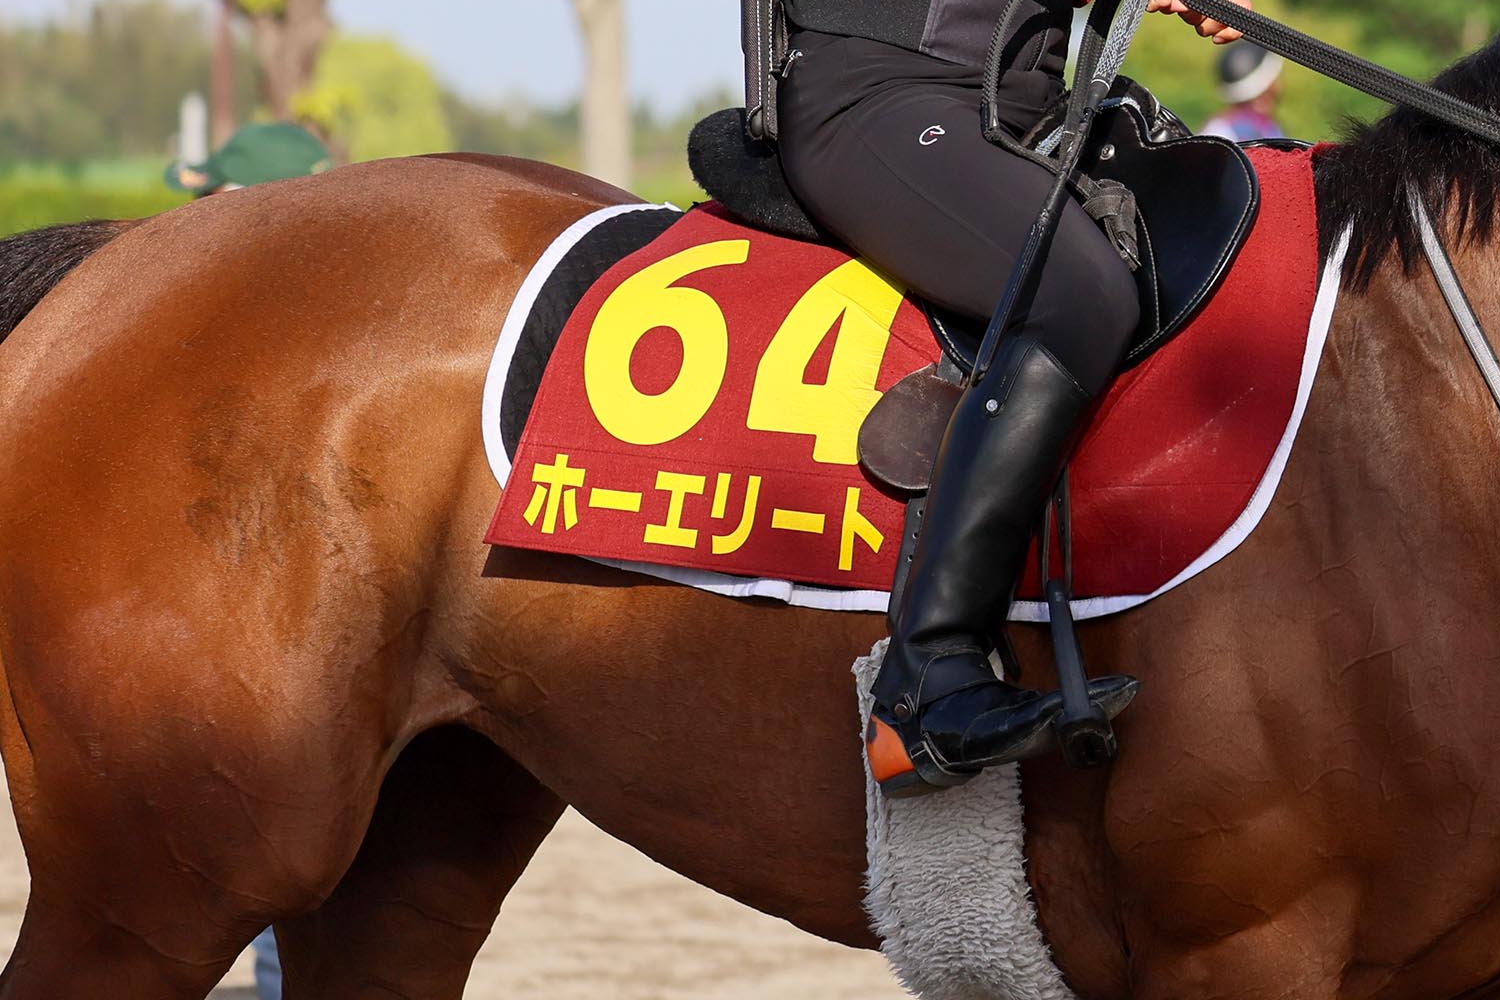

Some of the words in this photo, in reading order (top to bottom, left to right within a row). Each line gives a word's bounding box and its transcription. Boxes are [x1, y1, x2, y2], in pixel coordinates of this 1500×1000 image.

[584, 239, 904, 465] 64
[523, 454, 885, 571] ホーエリート
